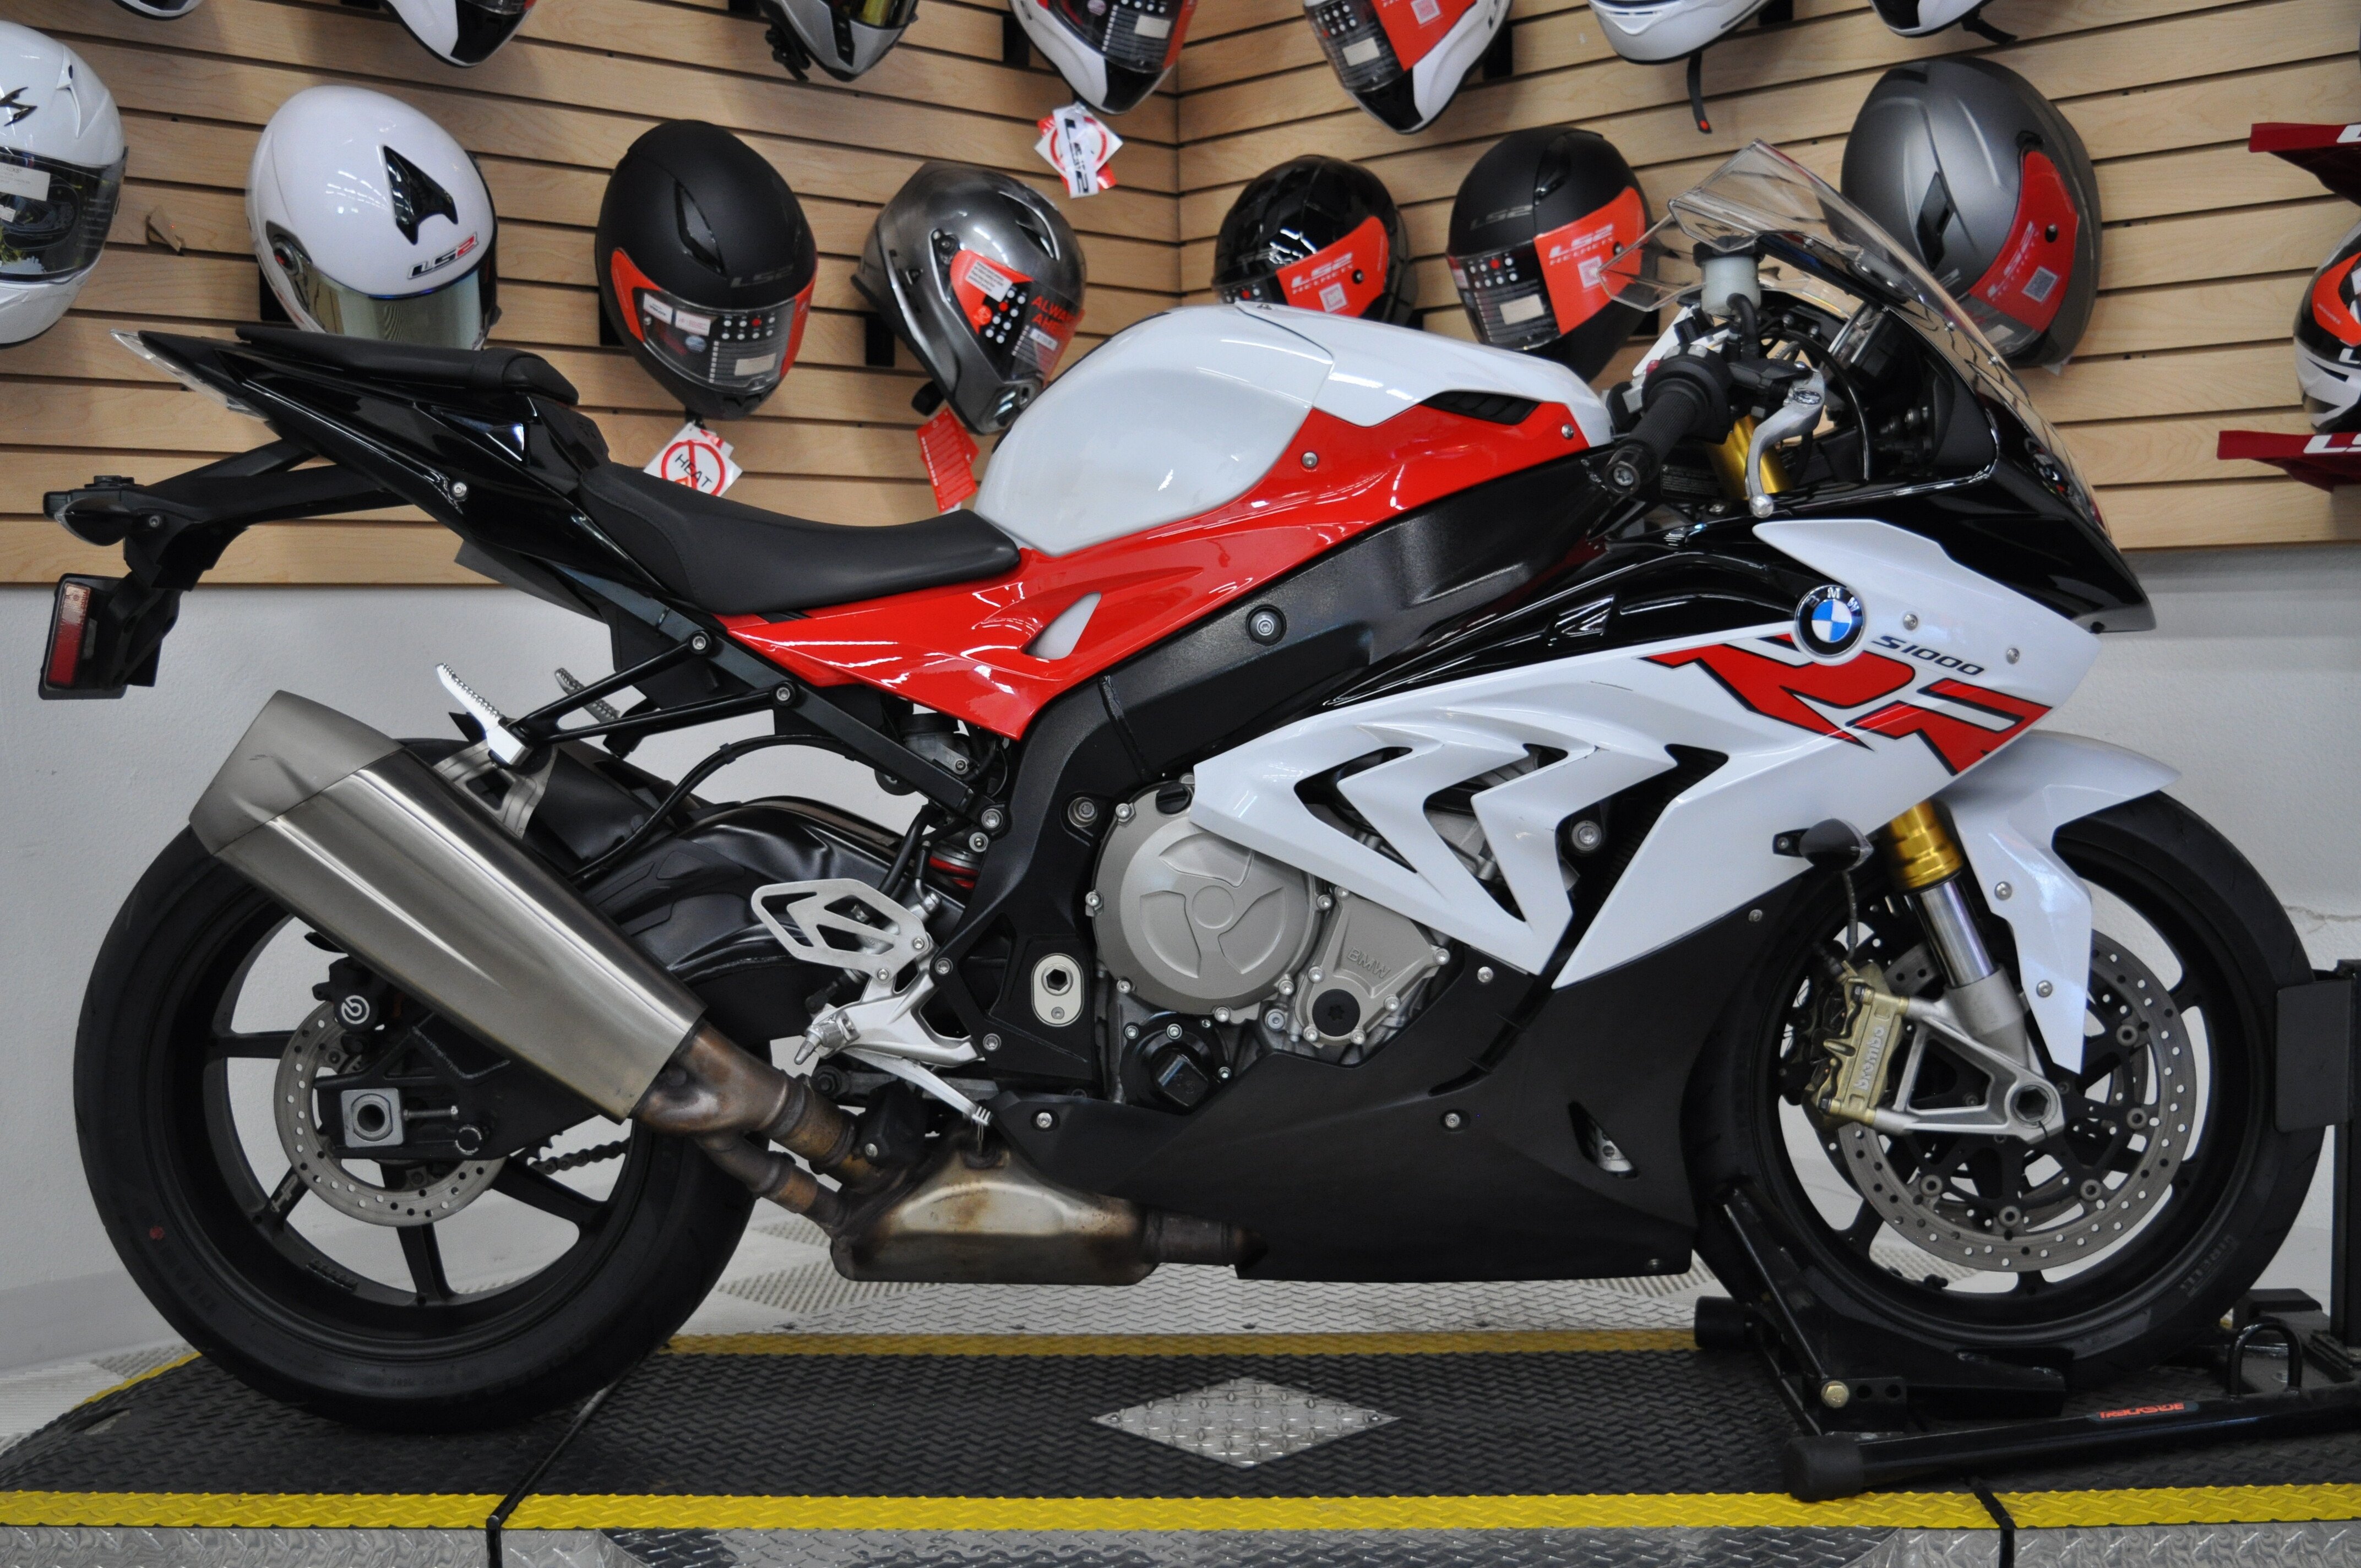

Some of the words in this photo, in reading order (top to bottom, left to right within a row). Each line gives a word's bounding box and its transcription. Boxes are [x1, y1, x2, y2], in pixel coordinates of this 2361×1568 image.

[1469, 204, 1534, 231] LS2
[408, 233, 478, 279] LS2
[1549, 223, 1614, 259] LS2
[730, 264, 795, 288] LS2
[1291, 252, 1353, 288] LS2
[1987, 221, 2036, 298] LS2
[674, 454, 712, 487] HEAT
[1805, 586, 1860, 612] BMW
[1871, 635, 1984, 676] S1000
[1347, 947, 1391, 979] BMW
[1853, 1026, 1885, 1091] brembo
